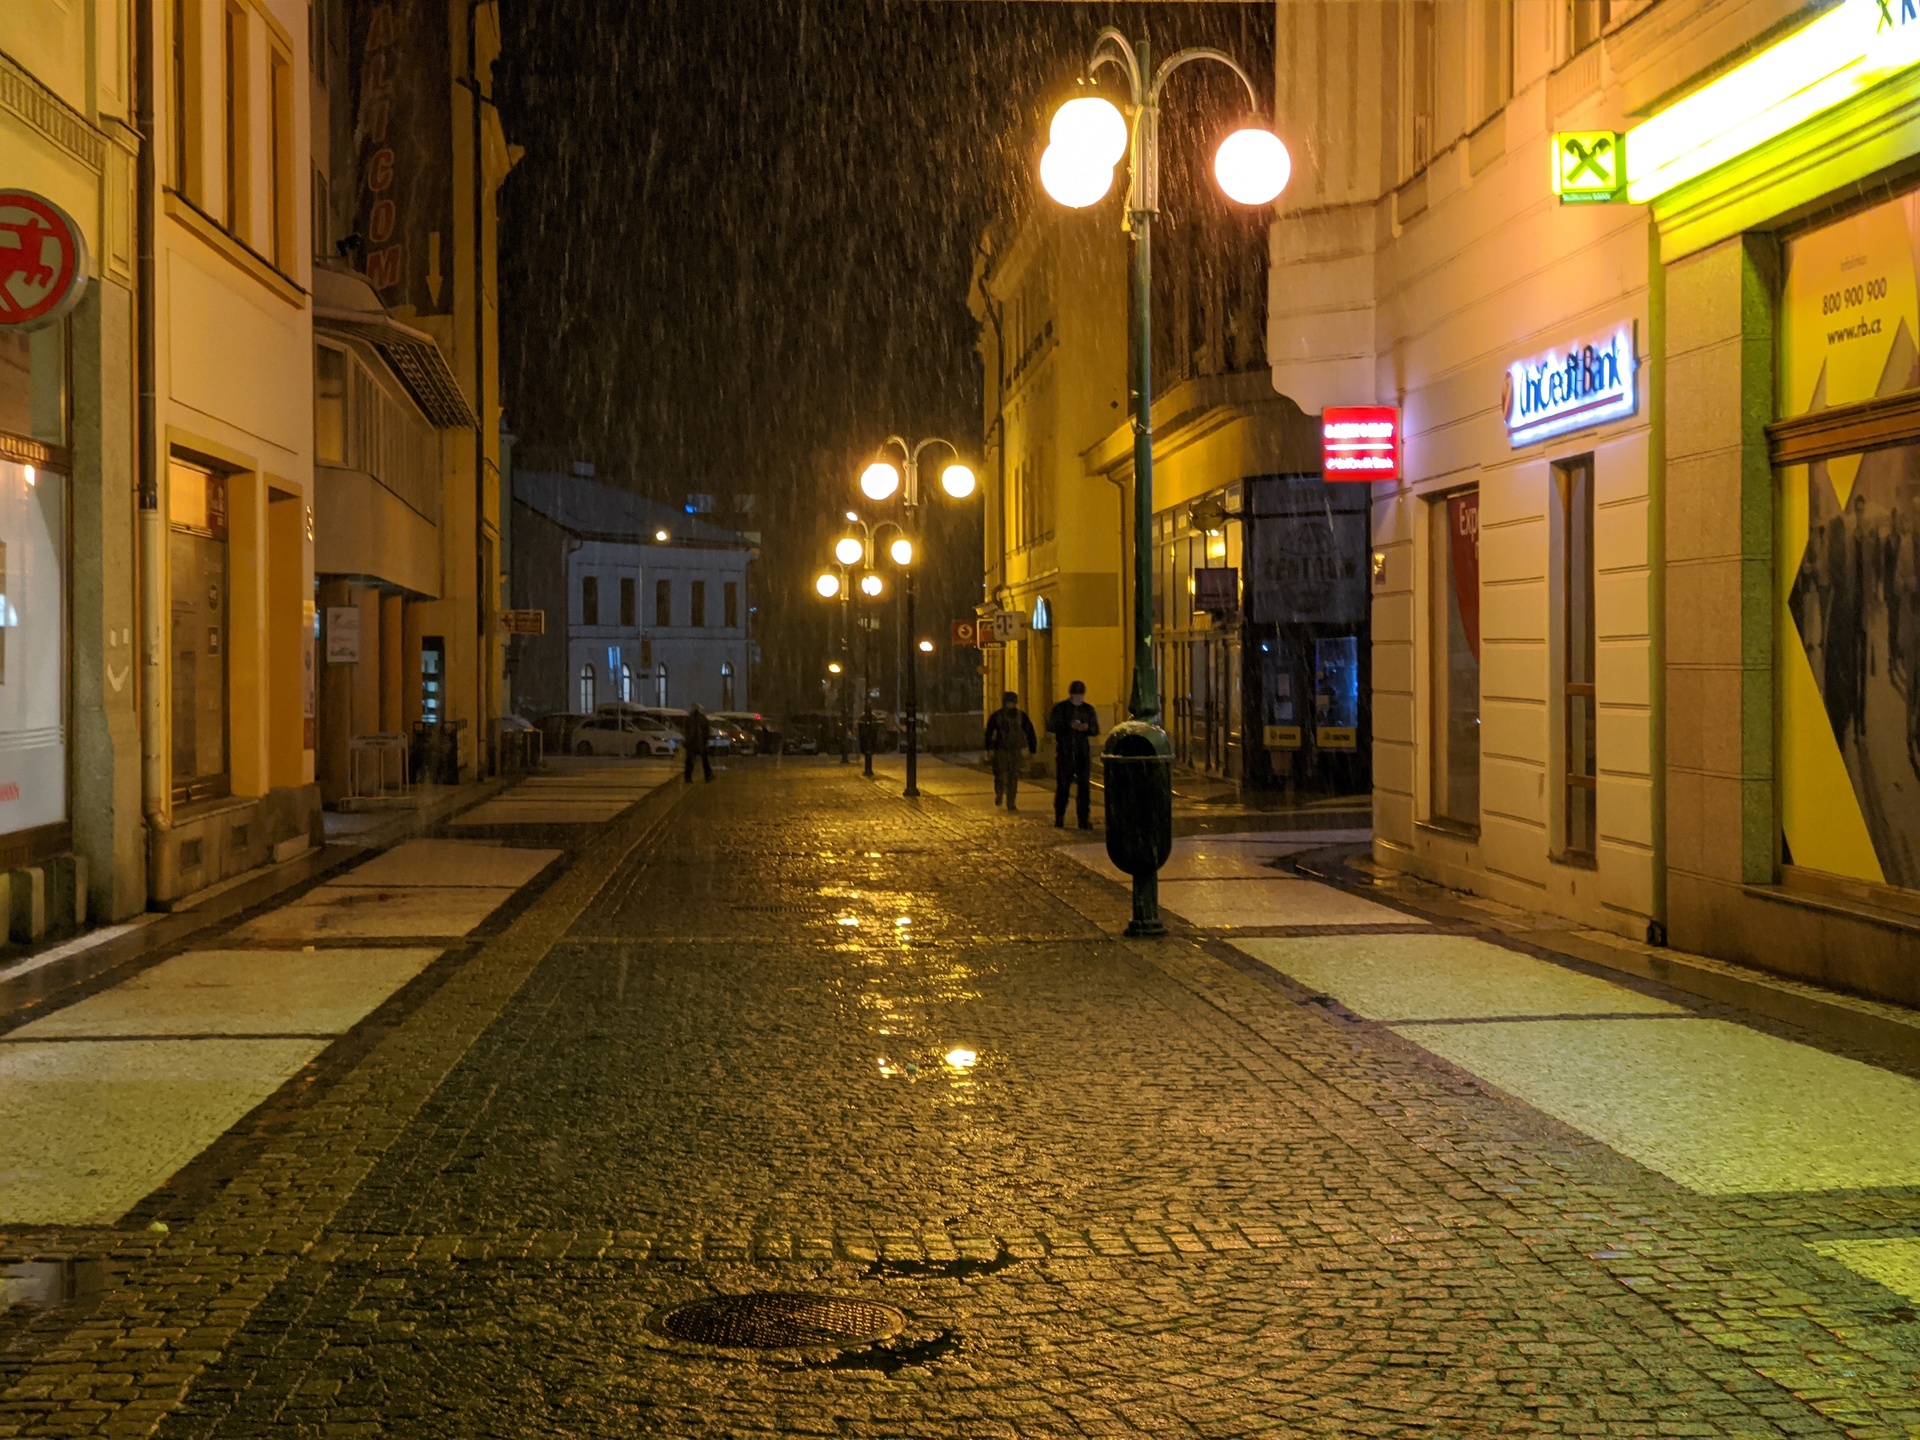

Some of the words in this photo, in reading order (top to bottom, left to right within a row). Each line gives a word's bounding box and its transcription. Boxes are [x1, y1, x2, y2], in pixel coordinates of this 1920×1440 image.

[1823, 292, 1841, 315] 800
[1844, 284, 1864, 308] 900
[1867, 277, 1887, 302] 900
[1827, 316, 1882, 345] www.rb.cz
